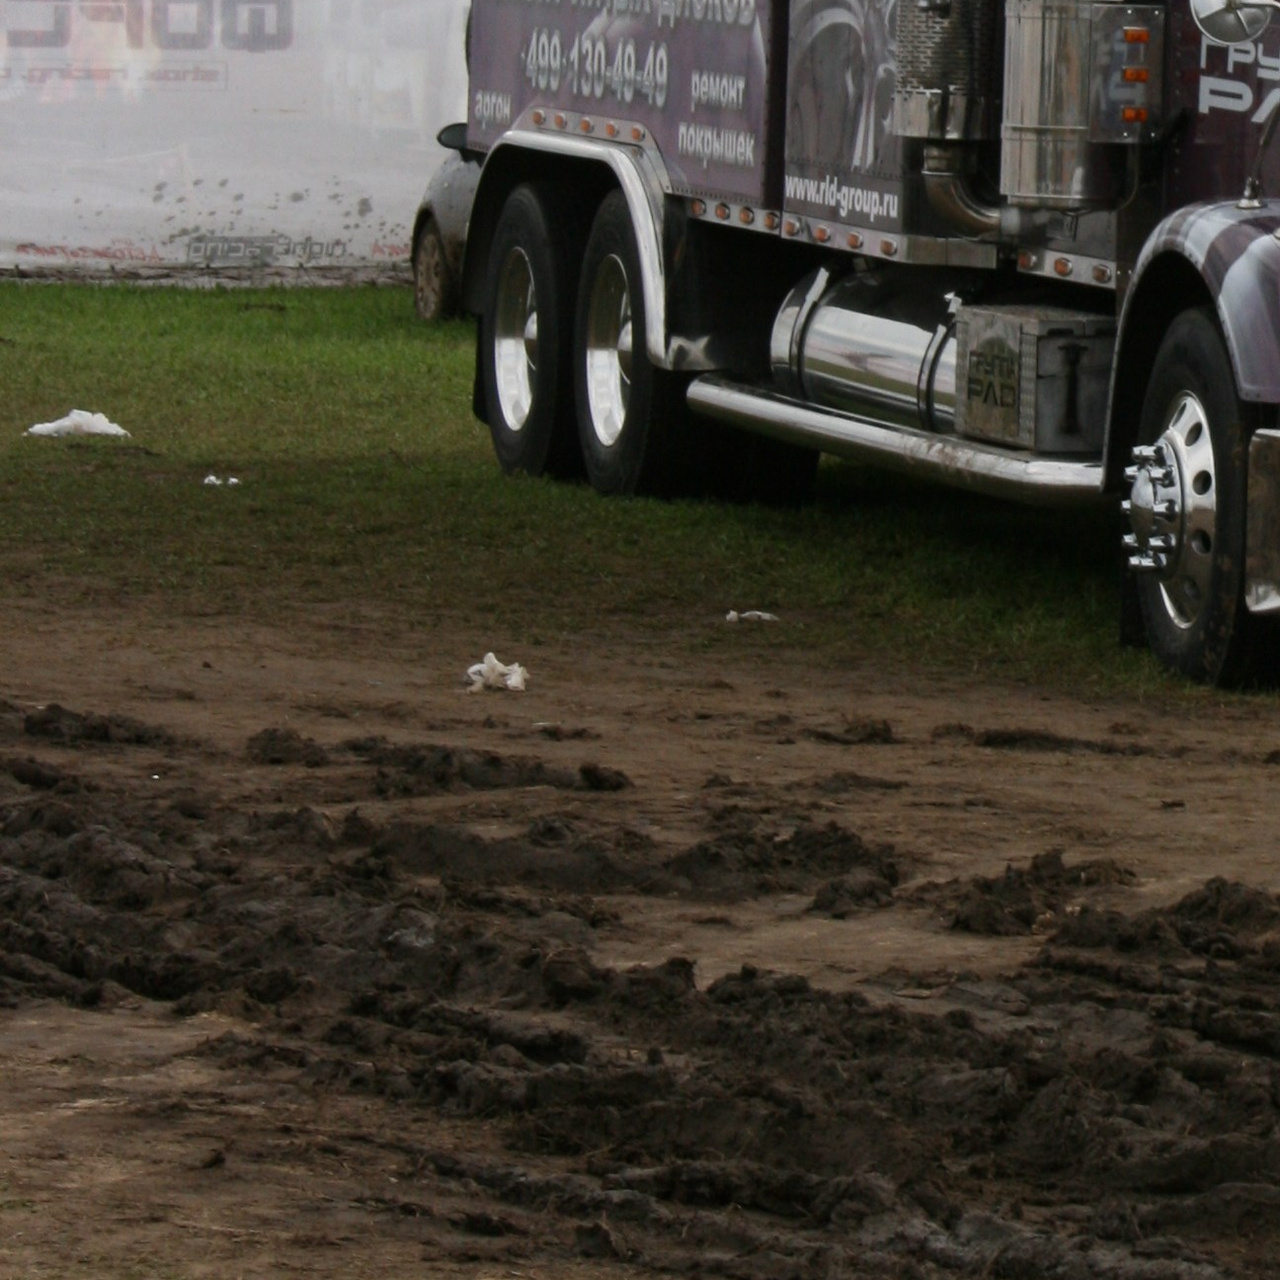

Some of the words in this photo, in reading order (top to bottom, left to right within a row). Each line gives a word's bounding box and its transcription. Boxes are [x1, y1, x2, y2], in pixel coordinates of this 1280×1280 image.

[474, 90, 511, 131] аргон
[691, 70, 747, 112] ремонт
[678, 123, 755, 168] покрышек
[785, 175, 899, 222] www.rld-group.ru
